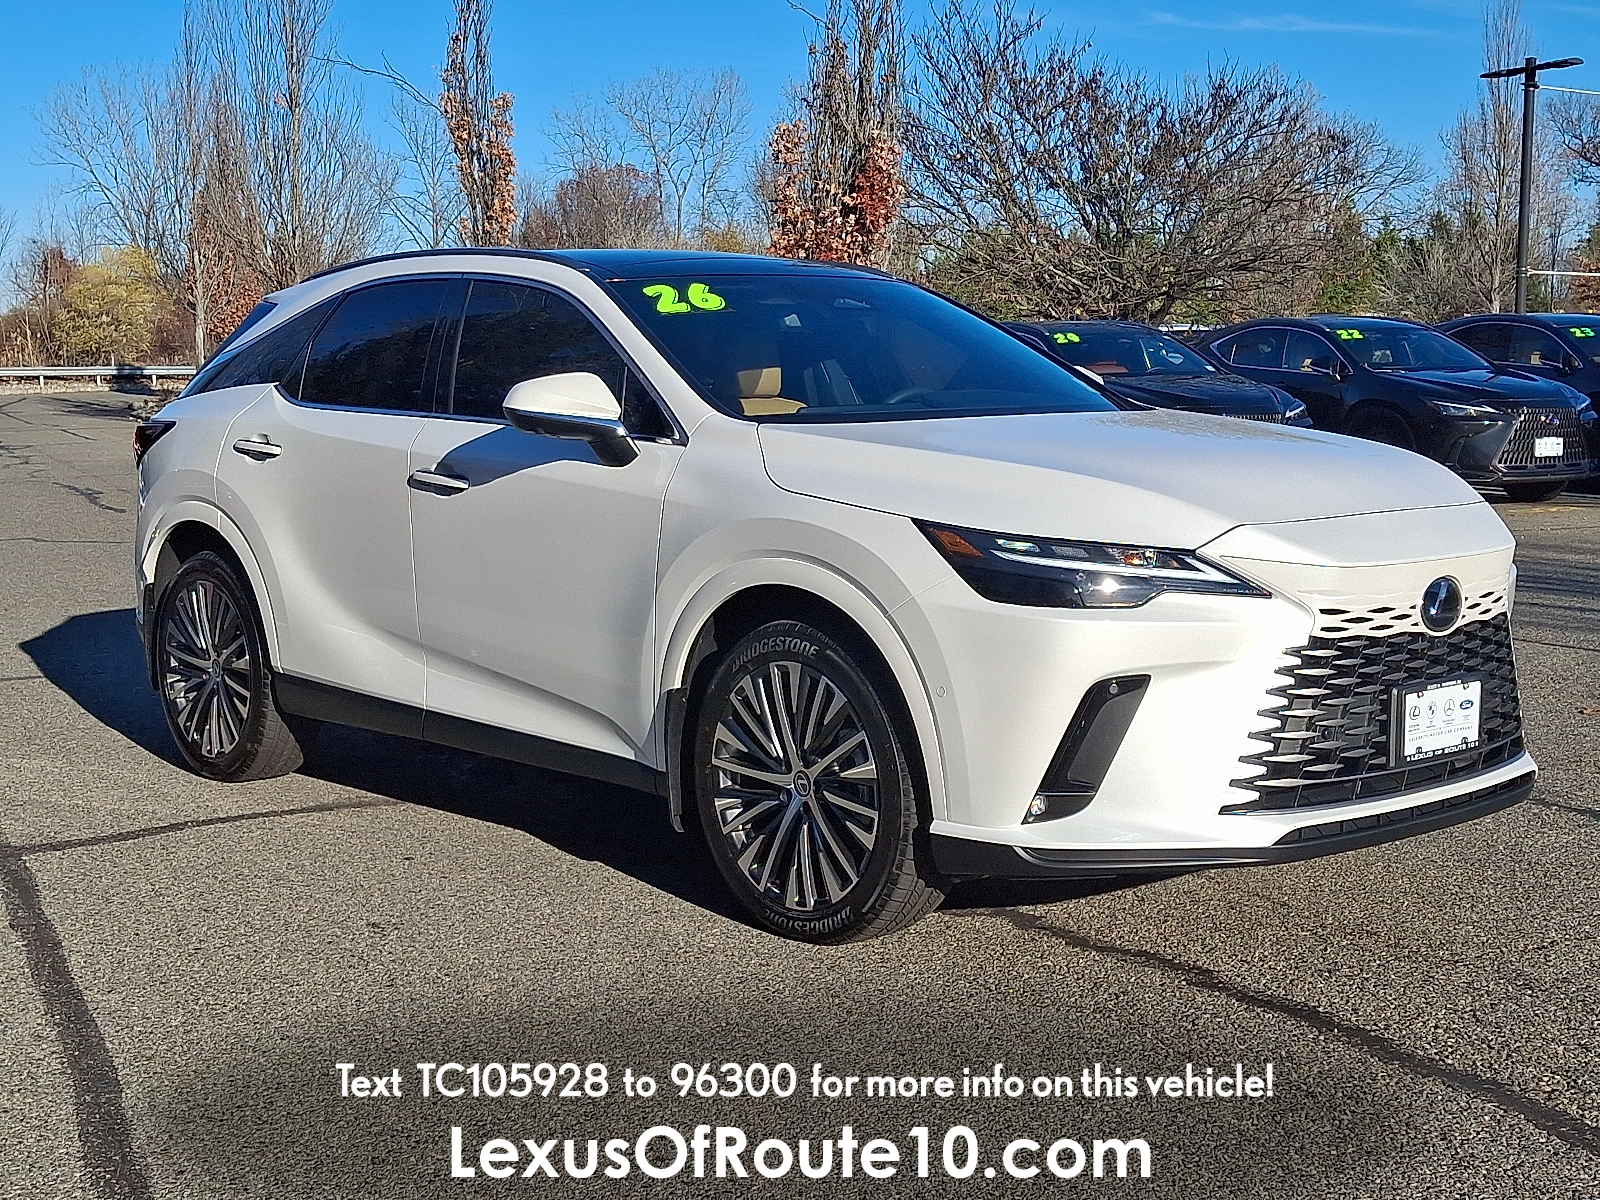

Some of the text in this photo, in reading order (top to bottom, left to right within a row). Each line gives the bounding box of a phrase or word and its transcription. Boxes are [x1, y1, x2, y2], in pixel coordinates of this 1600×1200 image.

[642, 282, 726, 314] 26
[1336, 329, 1364, 340] 22
[1569, 327, 1596, 338] 23
[731, 636, 820, 674] BRIDGESTONE
[1410, 751, 1434, 761] LEXUS
[1443, 743, 1467, 754] ROUTE
